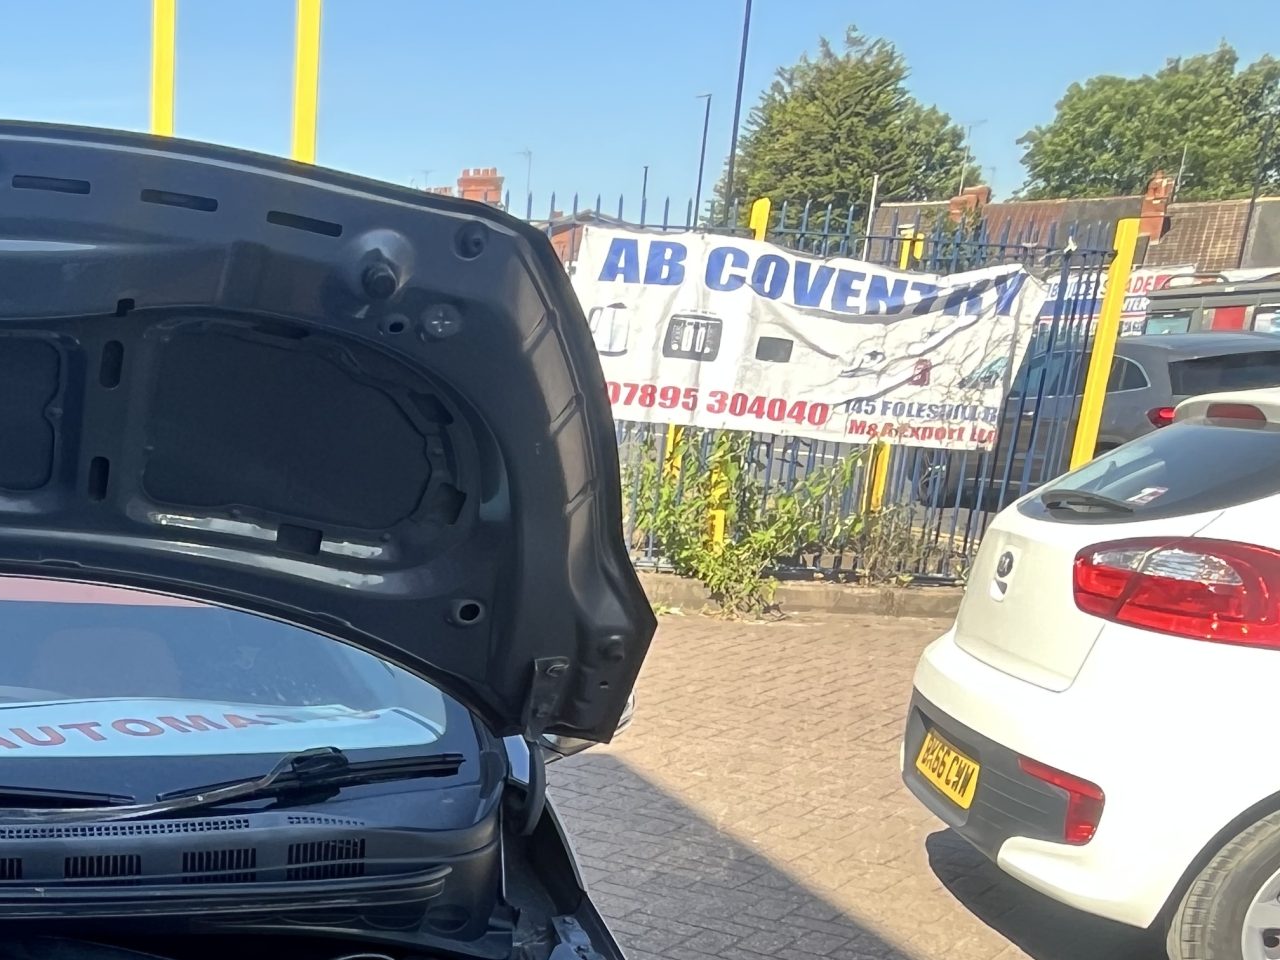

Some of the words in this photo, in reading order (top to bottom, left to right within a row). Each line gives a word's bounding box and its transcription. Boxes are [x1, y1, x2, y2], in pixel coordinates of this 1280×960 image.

[599, 238, 688, 286] AB
[607, 382, 699, 412] 07895
[706, 390, 830, 426] 304040
[844, 399, 876, 416] 145
